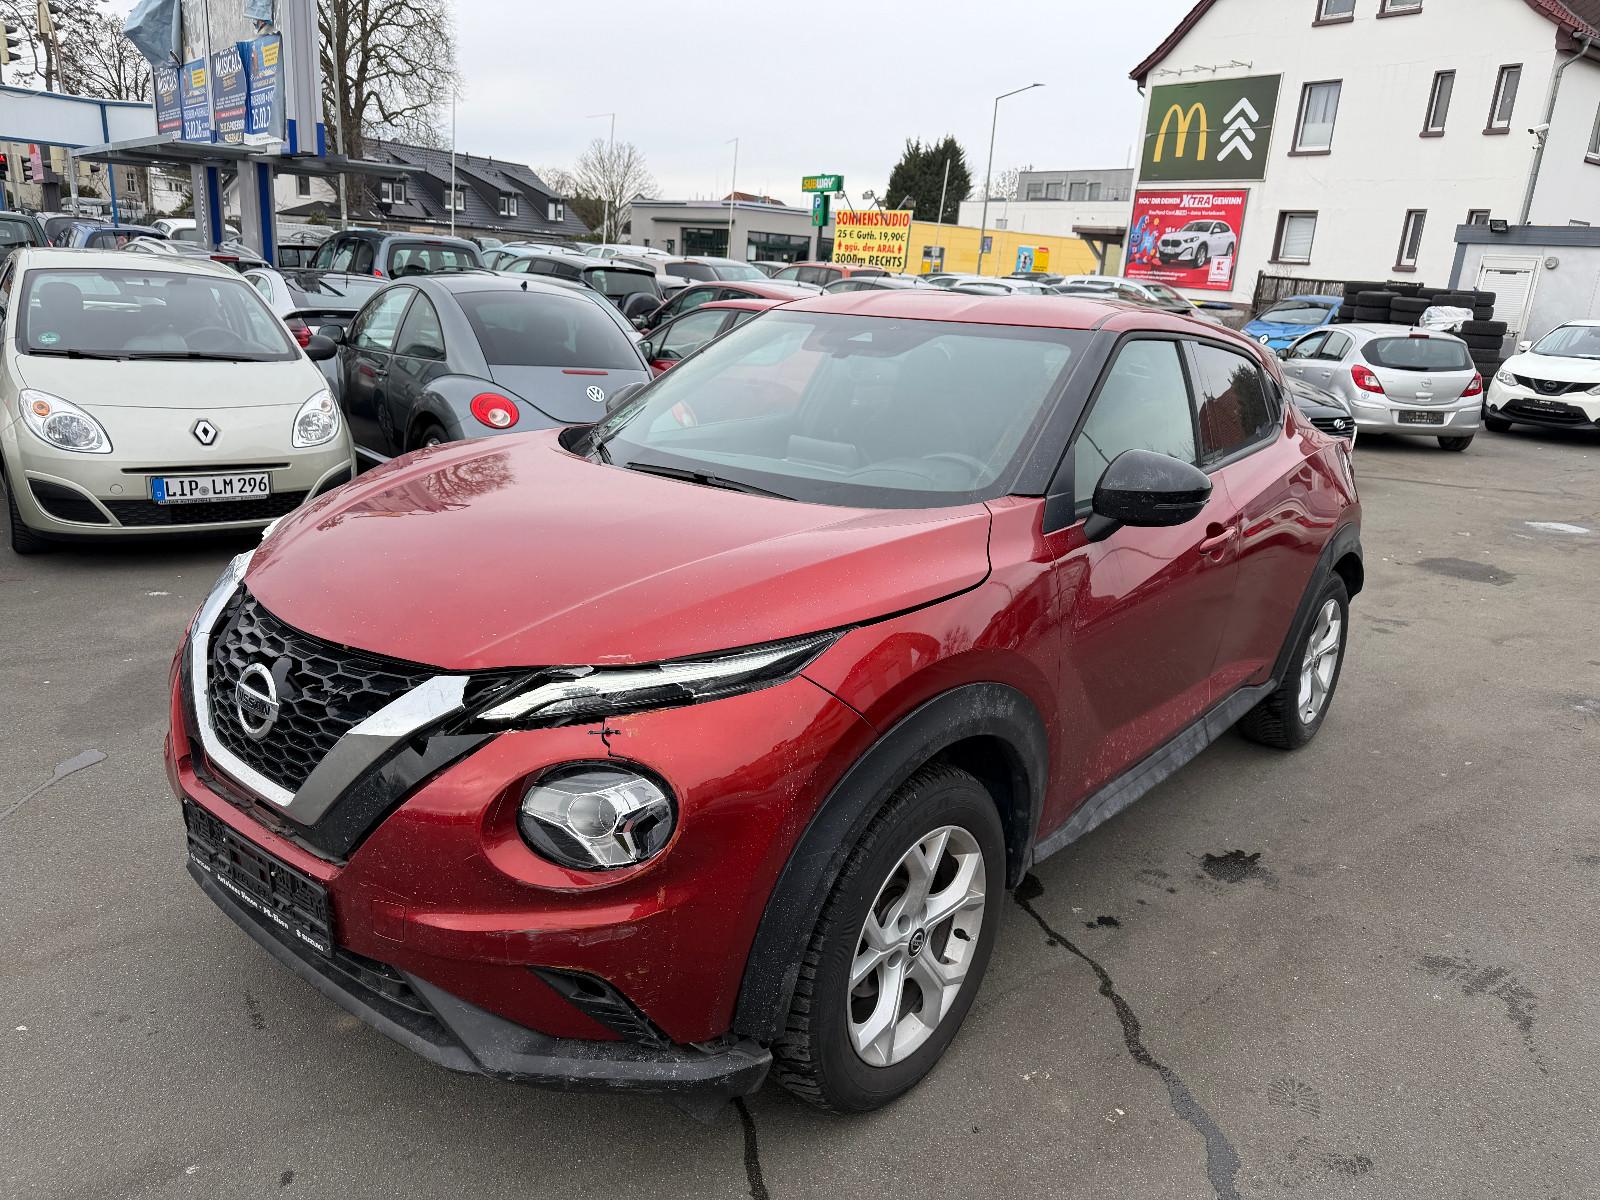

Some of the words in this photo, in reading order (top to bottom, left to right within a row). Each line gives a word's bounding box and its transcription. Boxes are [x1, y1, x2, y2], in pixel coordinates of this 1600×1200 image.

[802, 177, 834, 190] SUBWAY
[1213, 197, 1242, 205] GEWINN
[836, 211, 910, 227] SONNENSTUDIO
[837, 229, 847, 238] 25
[849, 230, 855, 238] €
[857, 230, 877, 240] Guth.
[879, 231, 906, 242] 19,90€
[862, 243, 875, 252] der
[876, 243, 895, 253] ARAL
[868, 255, 903, 267] RECHTS
[165, 480, 199, 497] LIP
[212, 478, 234, 495] LM
[237, 476, 267, 493] 296
[237, 689, 271, 716] NISSAN
